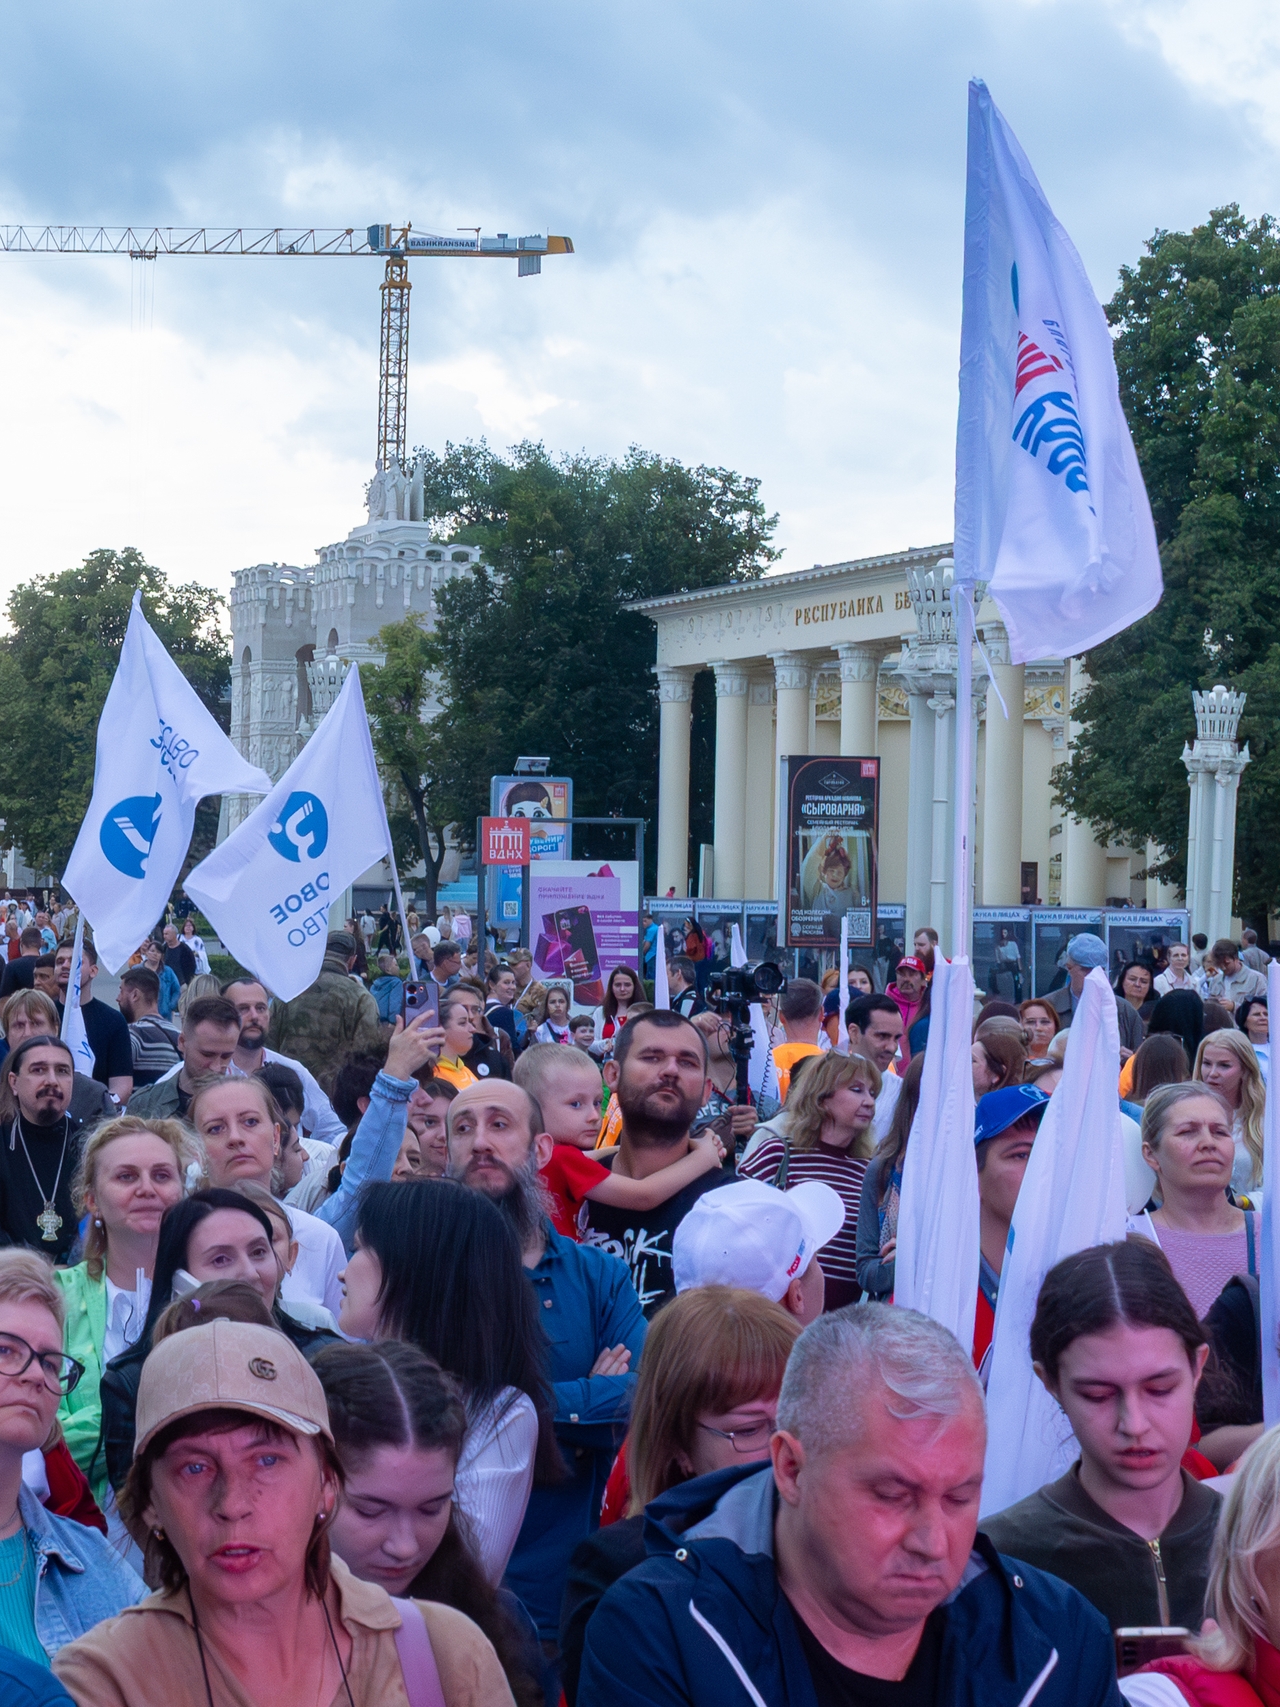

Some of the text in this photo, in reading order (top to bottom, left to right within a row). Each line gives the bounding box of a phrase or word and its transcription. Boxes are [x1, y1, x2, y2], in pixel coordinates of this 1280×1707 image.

[410, 239, 475, 248] BASHKRANSNAB
[795, 594, 884, 626] РЕСПУБЛИКА
[801, 802, 866, 816] «СЫРОВАРНЯ»
[489, 849, 523, 859] ВДНХ
